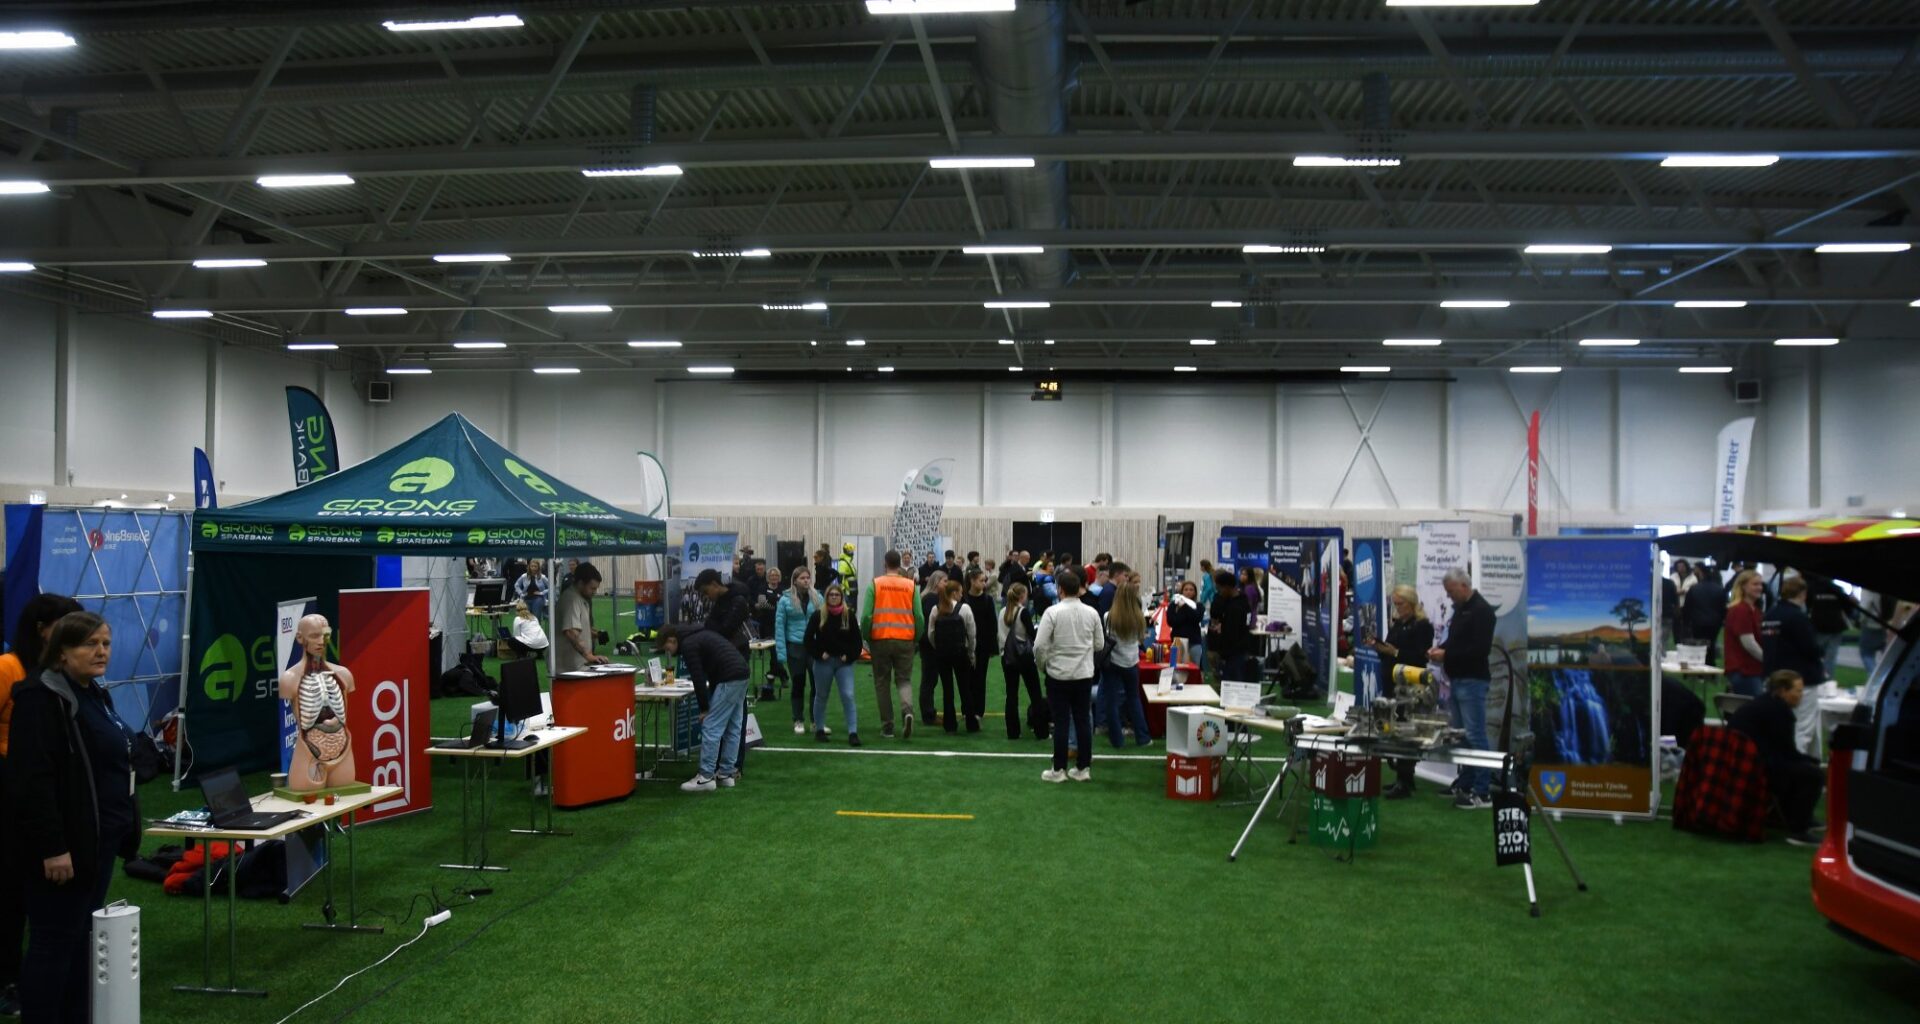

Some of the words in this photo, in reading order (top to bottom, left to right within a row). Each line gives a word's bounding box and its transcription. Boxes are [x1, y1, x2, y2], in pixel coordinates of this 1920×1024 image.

[323, 499, 479, 511] GRONG
[219, 524, 275, 534] GRONG
[307, 527, 363, 536] GRONG
[396, 528, 453, 538] GRONG
[487, 529, 545, 538] GRONG
[220, 533, 273, 541] SPAREBANK
[487, 538, 545, 546] SPAREBANK
[701, 542, 732, 555] GRONG
[282, 617, 293, 630] BDO
[372, 681, 403, 795] BDO
[1170, 758, 1176, 770] 4
